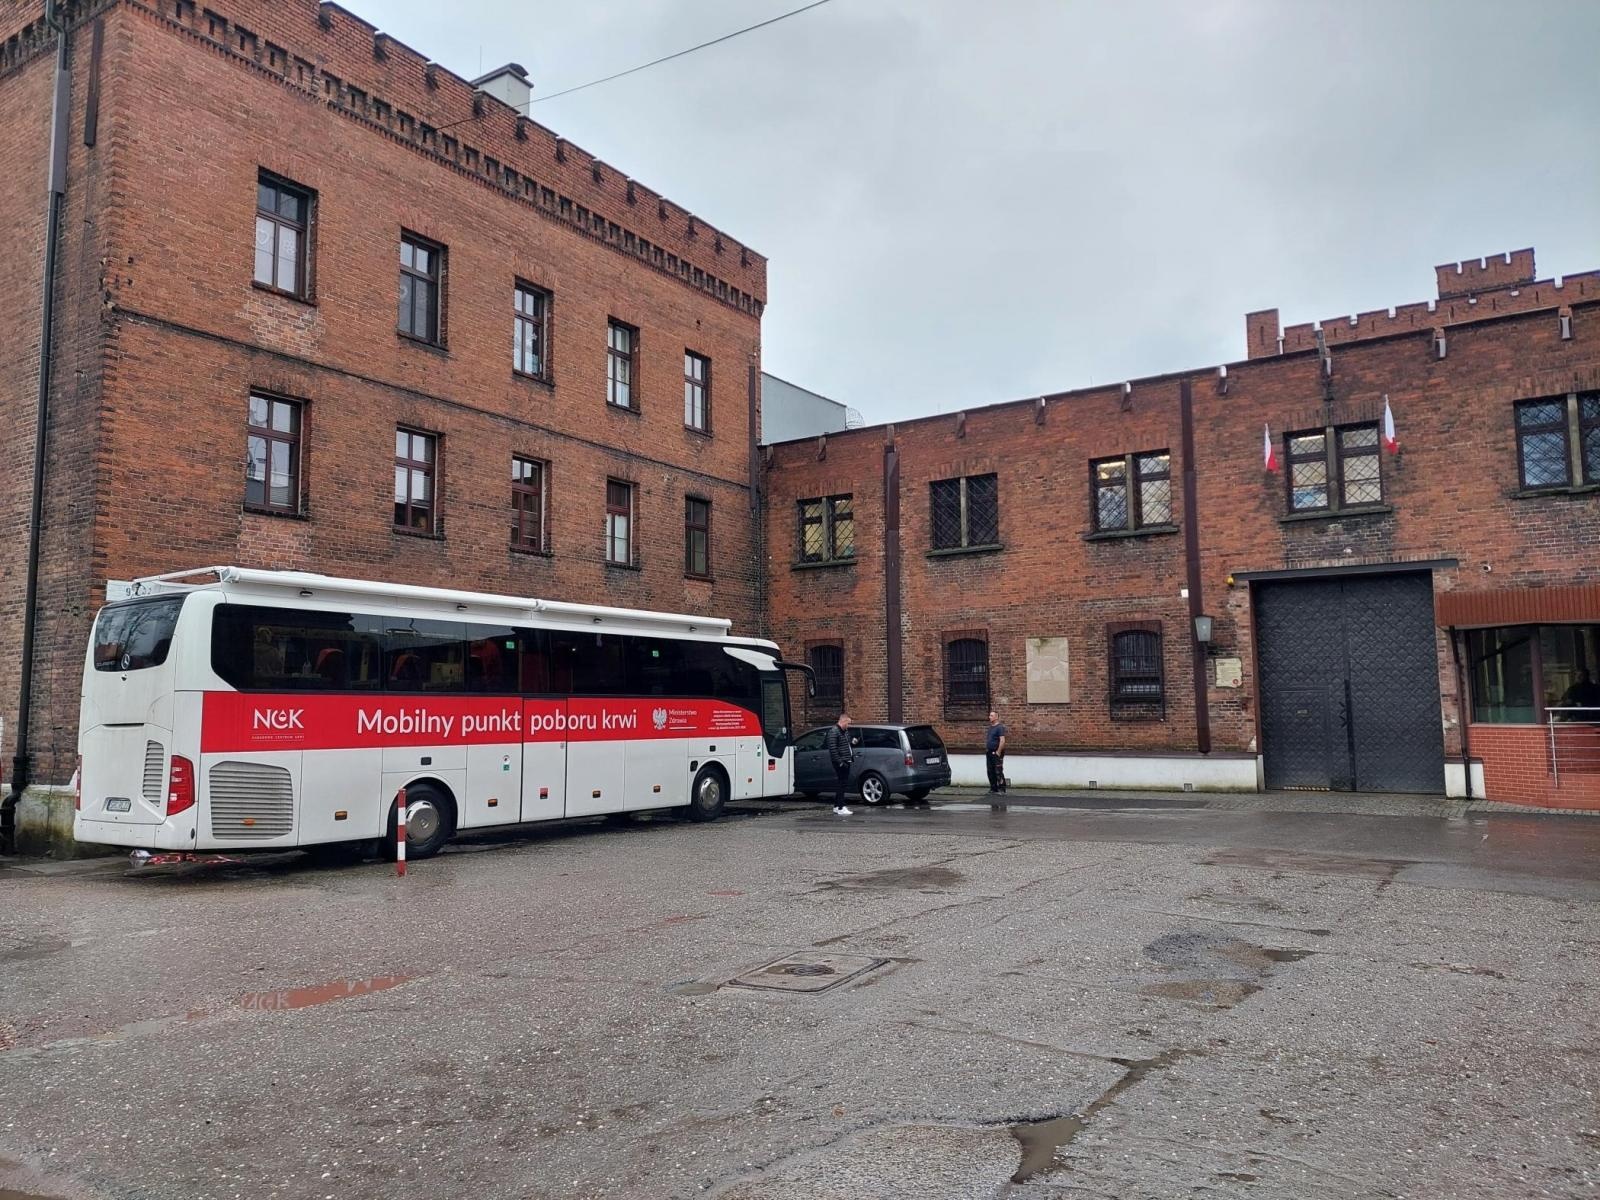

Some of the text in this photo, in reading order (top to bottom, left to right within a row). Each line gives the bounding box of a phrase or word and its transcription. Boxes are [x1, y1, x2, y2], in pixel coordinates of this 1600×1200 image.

[253, 708, 304, 729] NCK
[357, 708, 637, 737] Mobilny punkt poboru krwi
